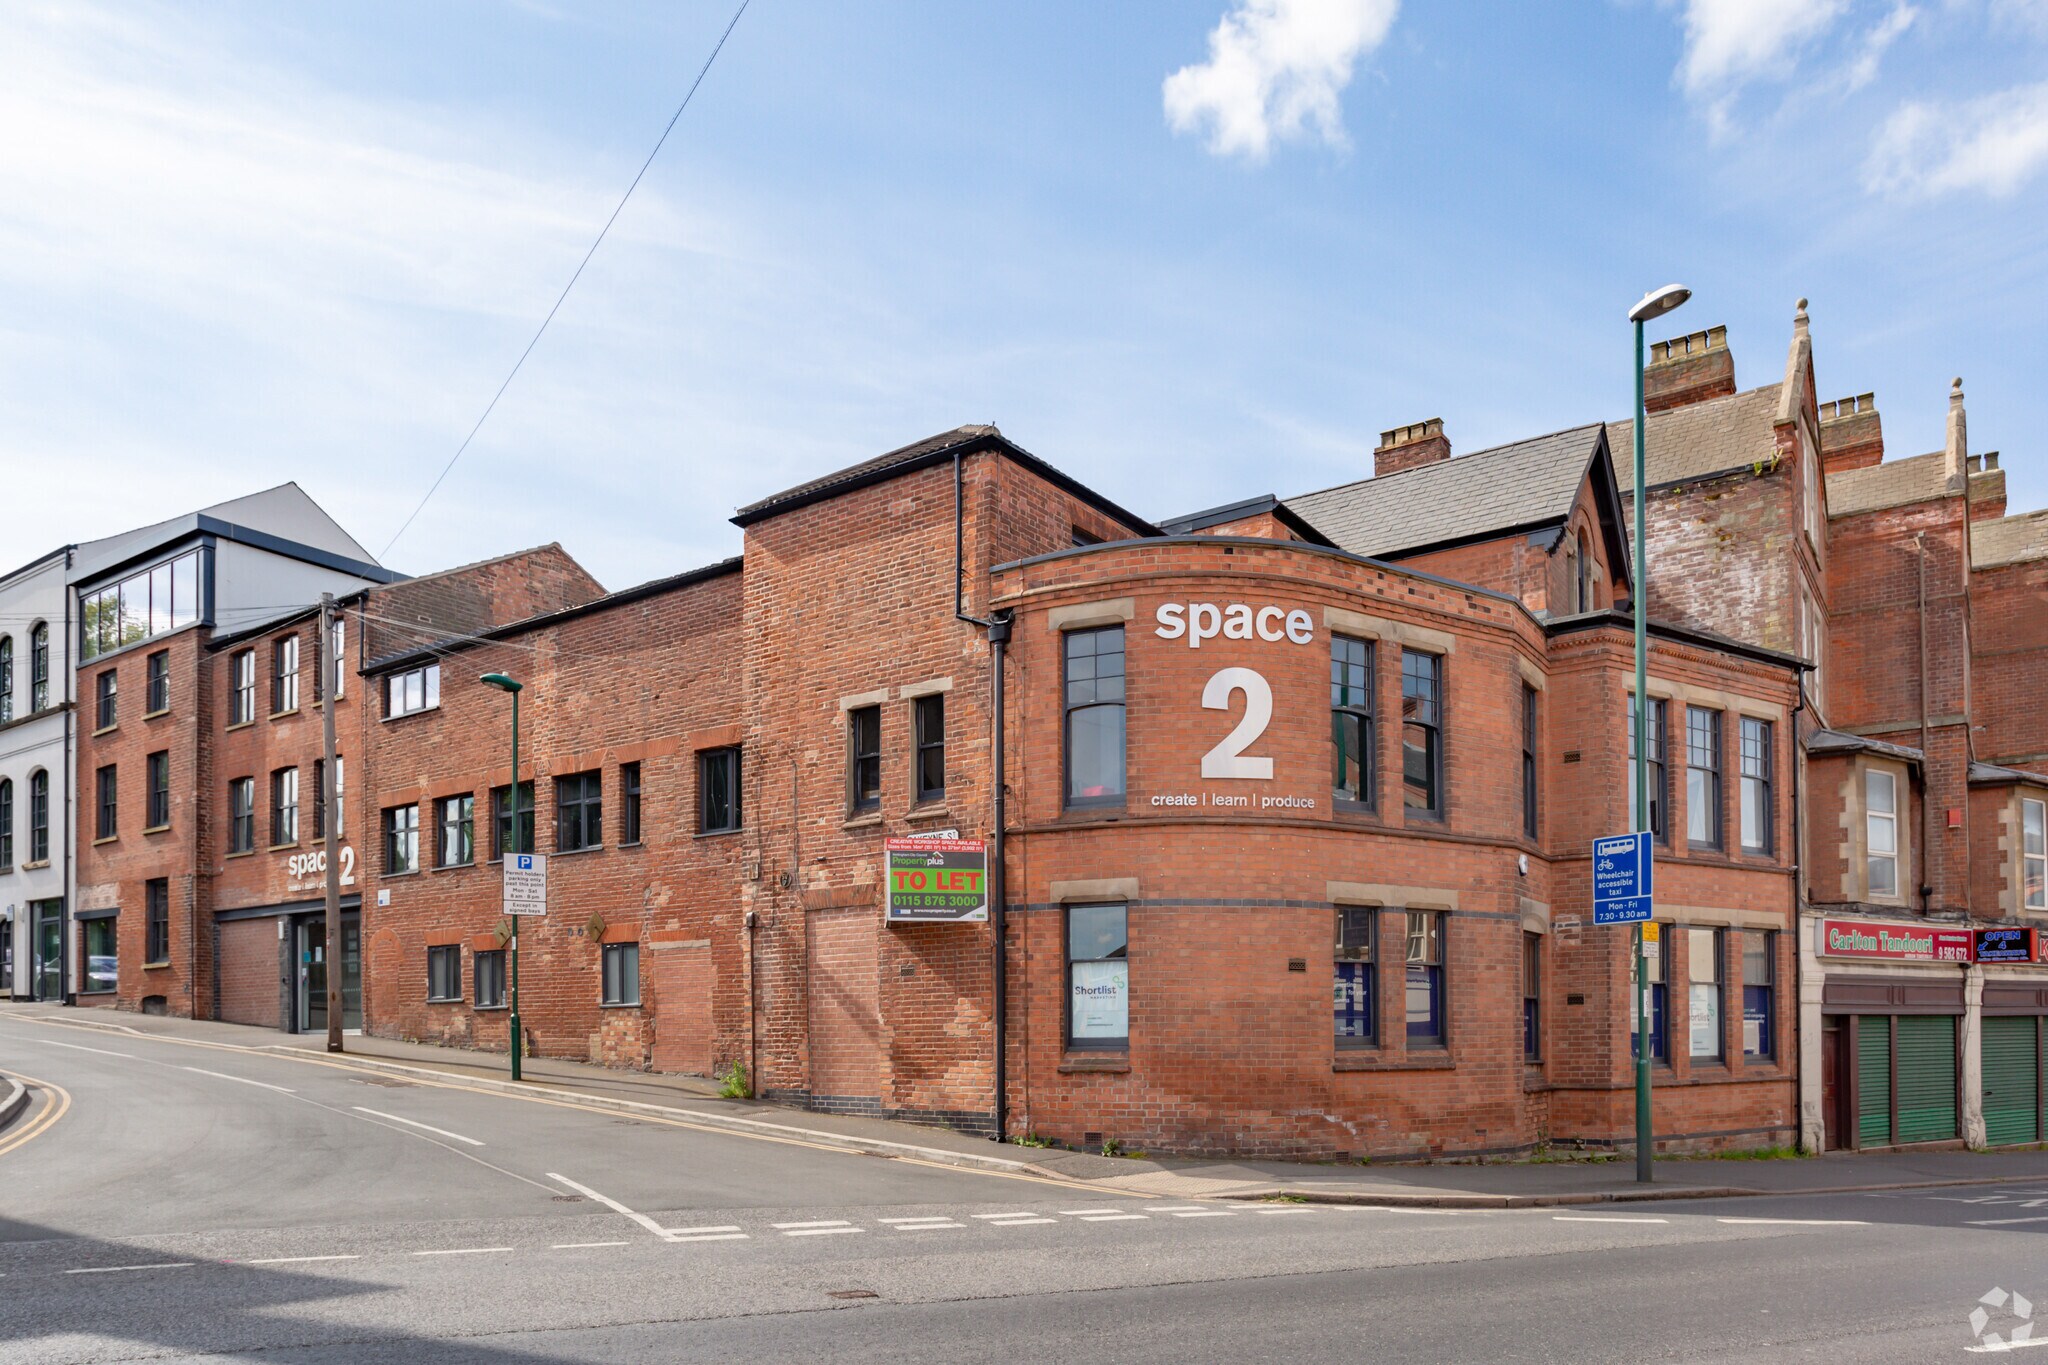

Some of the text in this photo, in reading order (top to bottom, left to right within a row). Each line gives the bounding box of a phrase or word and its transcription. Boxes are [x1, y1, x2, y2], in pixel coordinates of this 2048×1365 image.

[1154, 602, 1314, 649] space
[1200, 666, 1274, 780] 2
[1151, 793, 1198, 806] create
[1211, 792, 1248, 807] learn
[1261, 794, 1315, 809] produce
[288, 845, 355, 886] spac 2
[521, 857, 530, 867] P
[1597, 870, 1634, 880] Wheelchair
[893, 871, 981, 891] TO LET
[1597, 878, 1633, 889] accessible
[1608, 887, 1622, 896] taxi
[893, 895, 978, 906] 0115 876 3000
[1608, 902, 1624, 911] Mon
[1628, 901, 1638, 909] Fri
[1599, 912, 1614, 921] 7.30
[1619, 911, 1635, 919] 9.30
[1829, 927, 1933, 954] Carlton Tandoori
[1985, 930, 2021, 941] OPEN
[1997, 941, 2007, 950] 4
[1938, 946, 1943, 959] 9
[1943, 947, 1955, 960] 582
[1956, 947, 1967, 960] 672
[1075, 985, 1117, 995] Shortlist
[1690, 1013, 1710, 1022] ortlist
